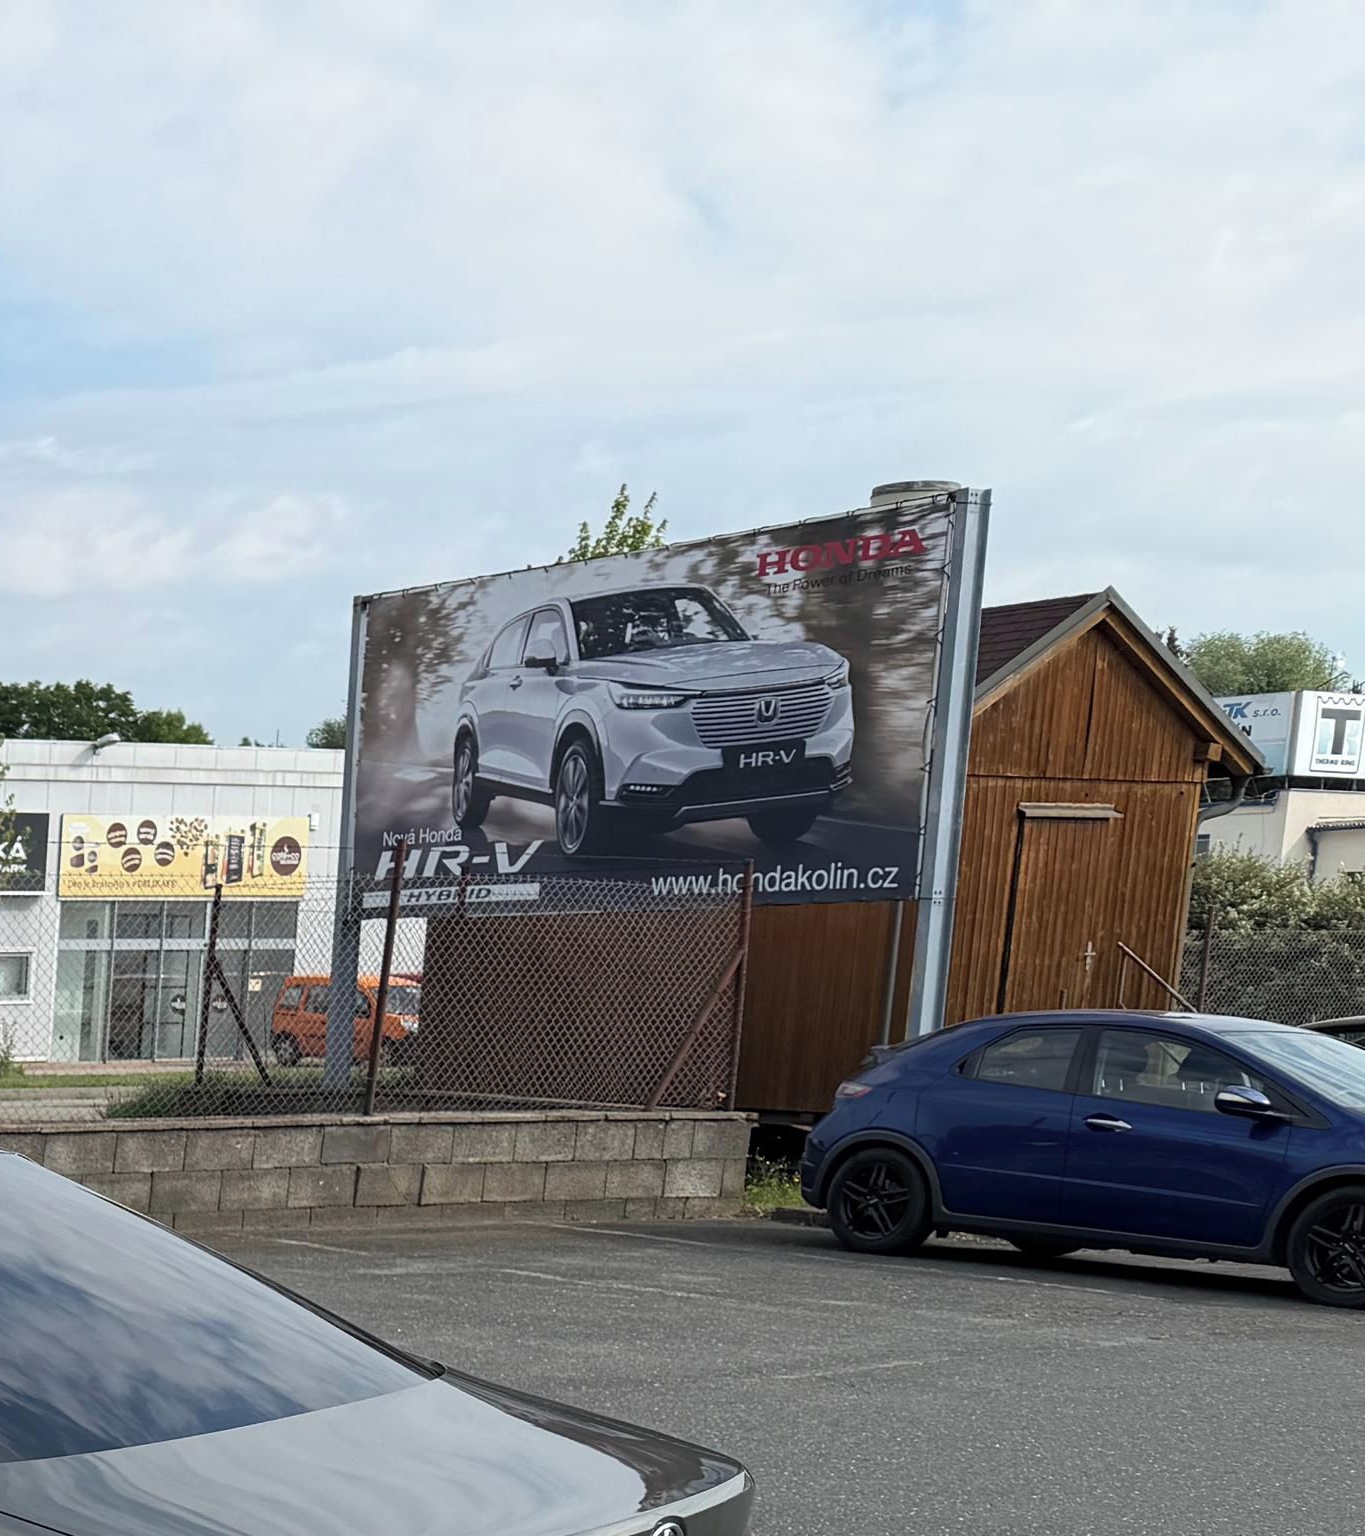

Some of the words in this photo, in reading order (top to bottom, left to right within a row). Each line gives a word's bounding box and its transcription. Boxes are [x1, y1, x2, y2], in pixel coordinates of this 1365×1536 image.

[756, 528, 932, 577] HONDA
[766, 582, 790, 595] The
[792, 575, 834, 591] Power
[839, 572, 854, 584] of
[857, 564, 913, 582] Dreams
[1253, 707, 1281, 718] s.r.o.
[739, 748, 797, 769] HR-V
[382, 828, 415, 847] Nová
[419, 828, 462, 844] Honda
[375, 840, 544, 881] HR-V
